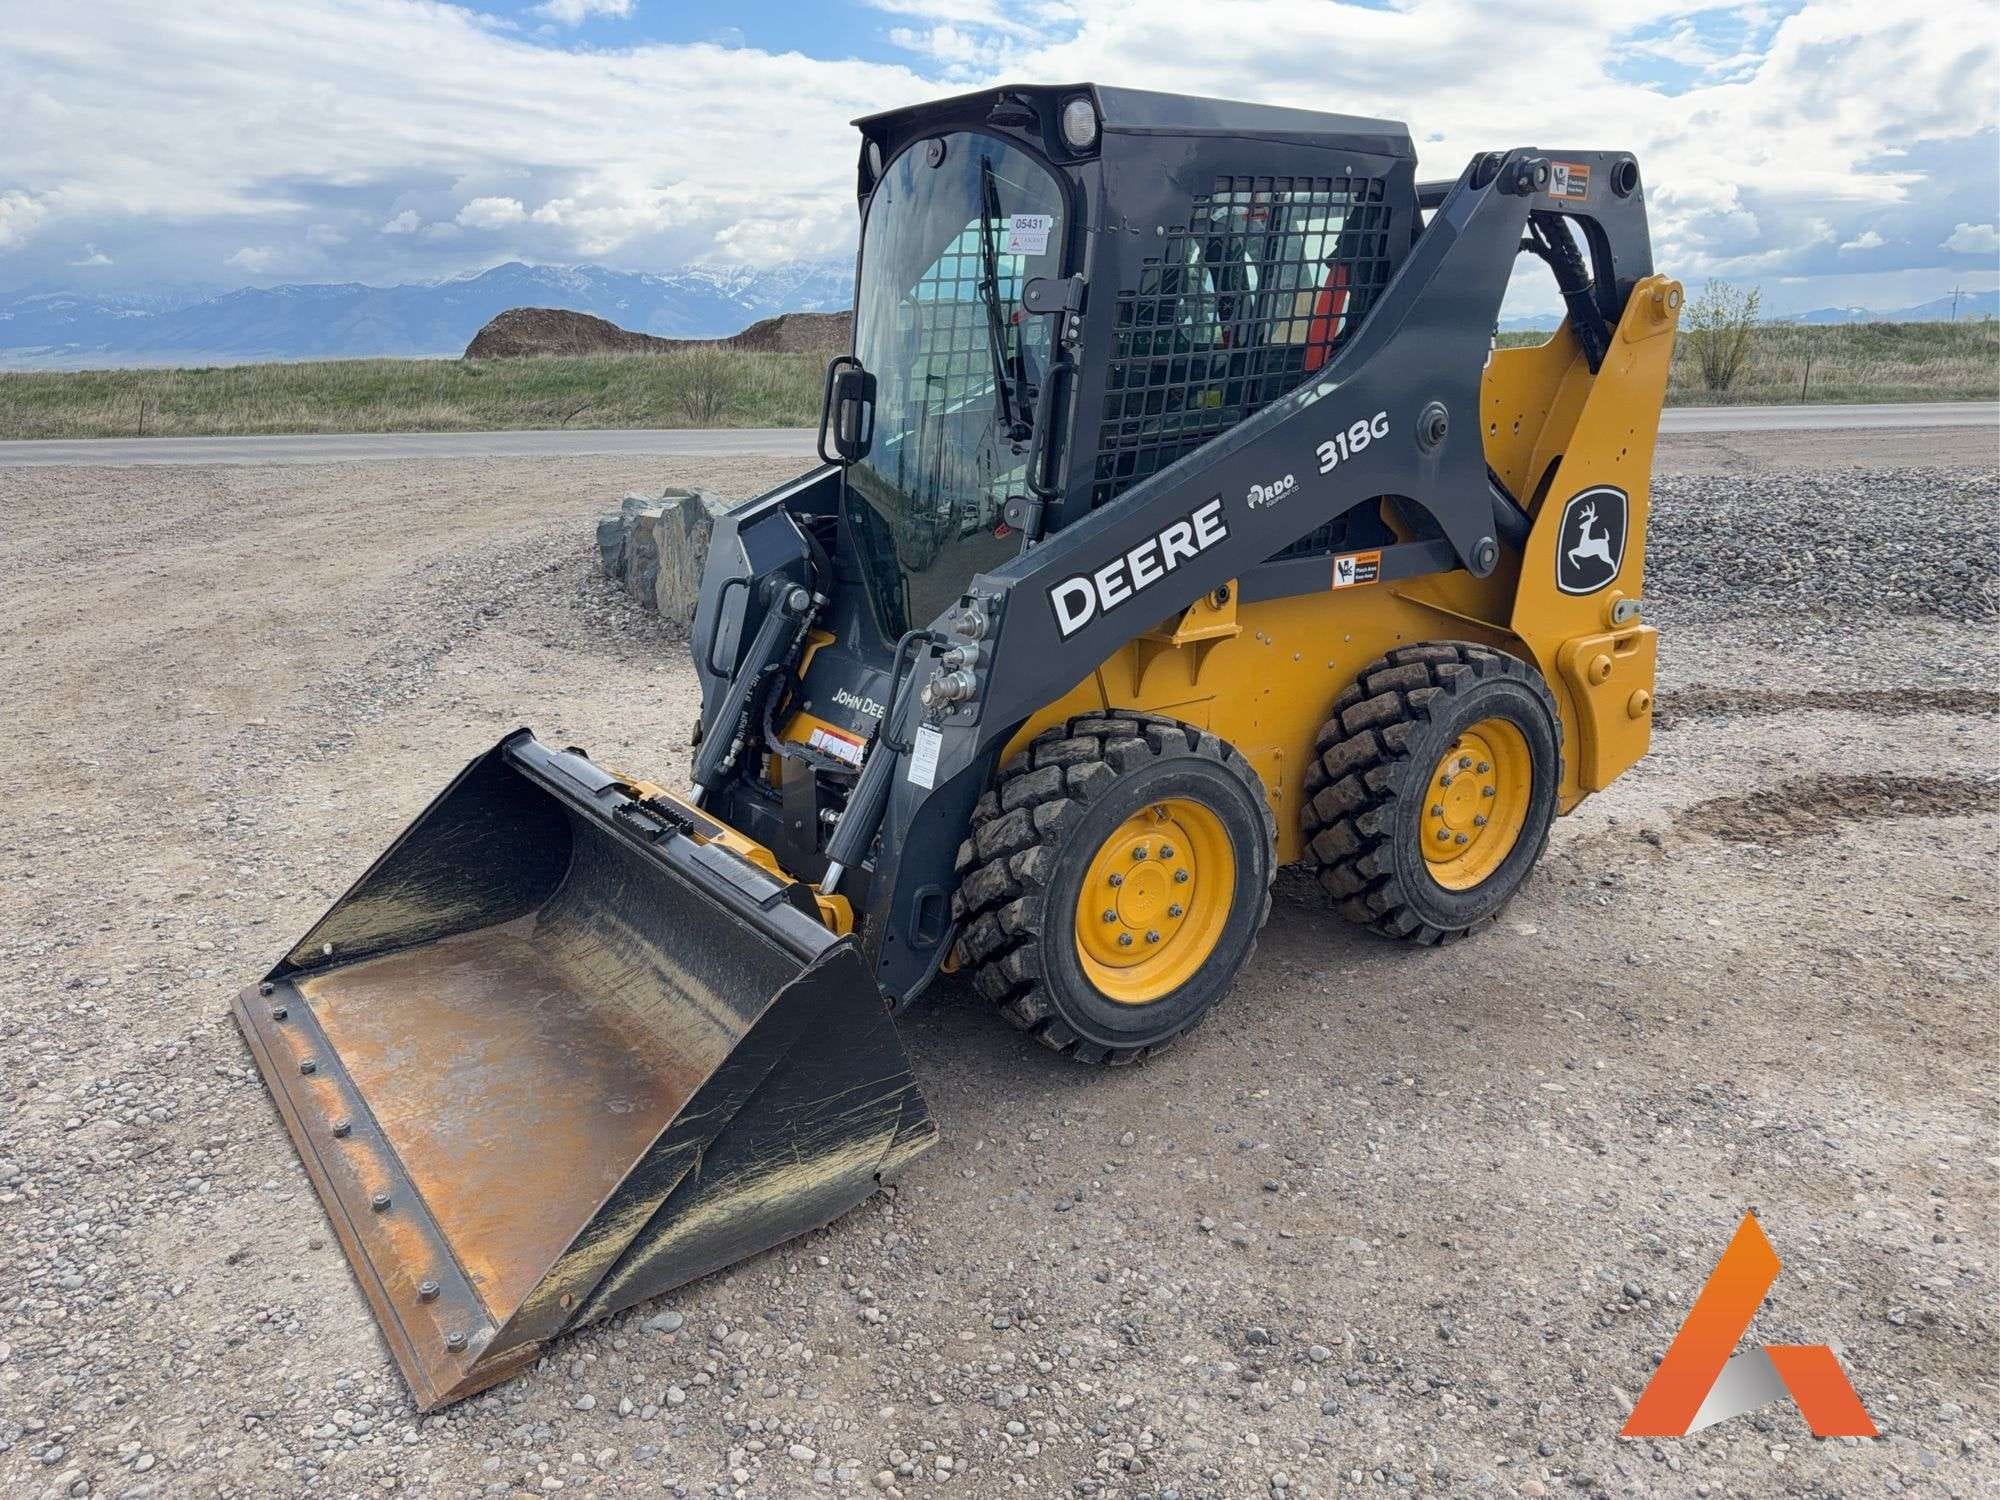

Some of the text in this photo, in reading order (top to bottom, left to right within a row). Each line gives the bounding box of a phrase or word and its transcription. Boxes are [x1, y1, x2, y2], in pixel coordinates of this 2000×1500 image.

[1015, 218, 1043, 229] 05431
[1316, 411, 1389, 474] 318G
[1050, 499, 1227, 637] DEERE
[832, 687, 885, 719] JOHN DEE
